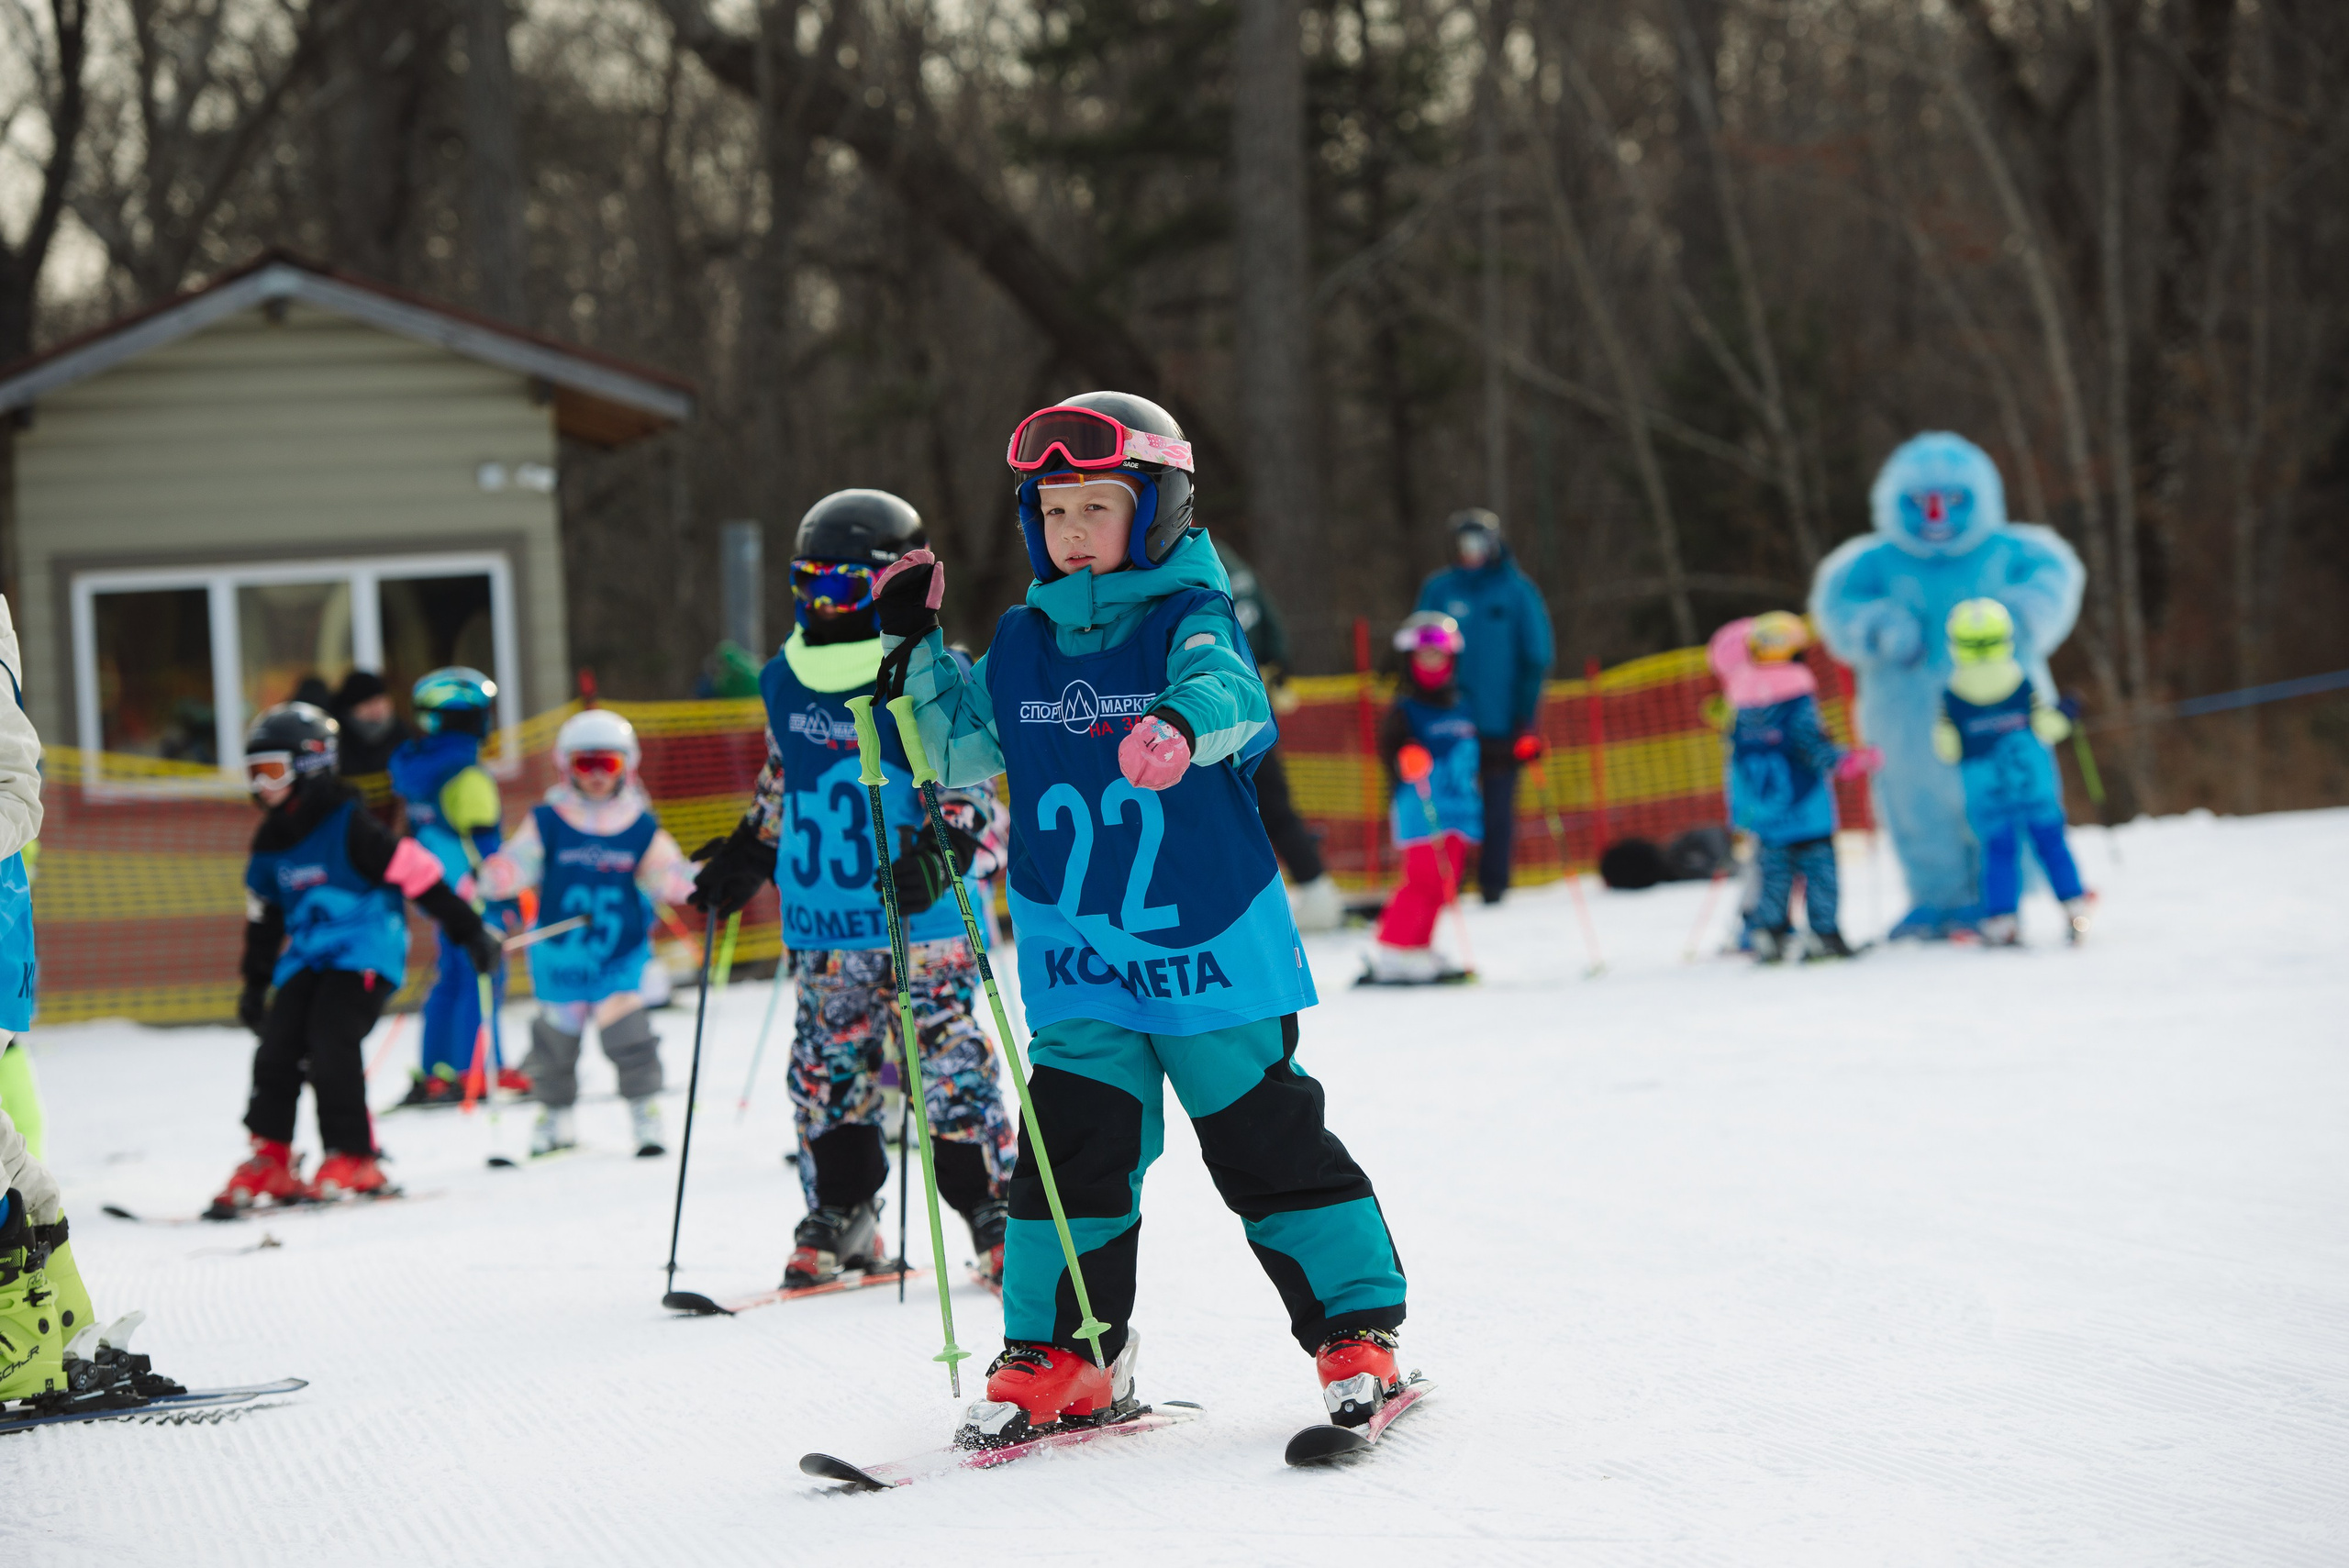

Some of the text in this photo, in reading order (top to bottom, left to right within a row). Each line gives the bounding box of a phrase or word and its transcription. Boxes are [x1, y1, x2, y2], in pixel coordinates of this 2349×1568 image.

[1020, 696, 1156, 720] СПОРТ МАРКЕ
[1089, 720, 1114, 739] НА
[792, 778, 874, 889] 53
[1037, 777, 1180, 934] 22
[785, 903, 916, 939] КОМЕТ
